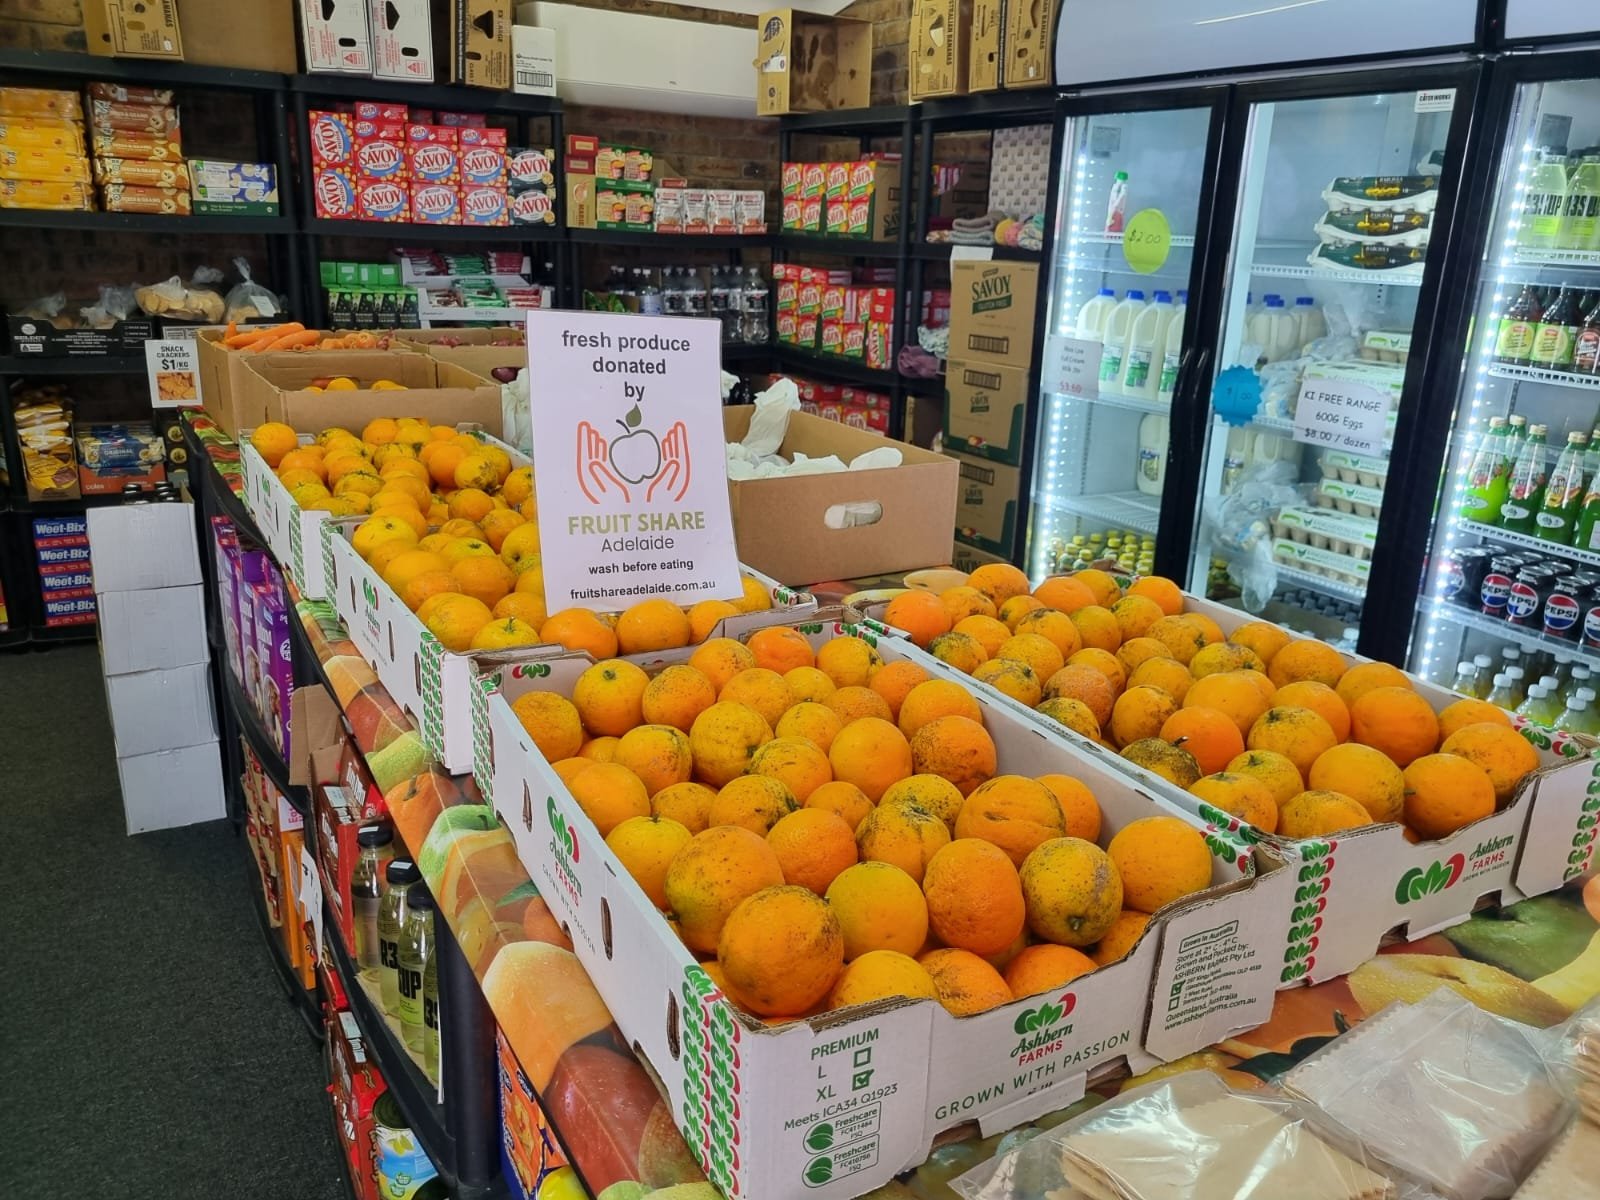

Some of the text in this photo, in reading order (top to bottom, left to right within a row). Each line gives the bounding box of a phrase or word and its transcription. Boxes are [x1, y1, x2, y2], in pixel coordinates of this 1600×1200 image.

[320, 120, 341, 163] SAVOY
[358, 149, 399, 168] SAVOY
[413, 153, 451, 170] SAVOY
[463, 155, 500, 171] SAVOY
[511, 159, 550, 177] SAVOY
[322, 174, 345, 215] SAVOY
[362, 189, 400, 208] SAVOY
[415, 193, 453, 210] SAVOY
[464, 194, 500, 211] SAVOY
[513, 197, 552, 215] SAVOY
[972, 274, 1012, 302] SAVOY
[562, 331, 691, 353] fresh produce
[592, 356, 667, 375] donated
[624, 381, 646, 401] by
[1304, 391, 1382, 412] KI FREE RANGE
[1315, 411, 1363, 430] 600G Eggs
[1305, 427, 1332, 442] $8.00
[1343, 435, 1371, 450] dozen
[36, 522, 85, 535] Weet-Bix
[568, 511, 706, 535] FRUIT SHARE
[601, 535, 675, 553] Adelaide
[40, 548, 89, 561] Weet-Bix
[589, 558, 694, 575] wash before eating
[44, 574, 93, 587] Weet-Bix
[570, 579, 716, 600] fruitshareadelaide.com.au
[1482, 583, 1510, 596] PEPS
[48, 600, 95, 613] Weet-Bix
[1546, 605, 1577, 618] PEPSI
[1469, 835, 1514, 861] Ashbern
[549, 836, 583, 898] Ashbern
[1472, 851, 1505, 872] FARMS
[554, 861, 580, 907] FARMS
[1176, 952, 1194, 964] Store
[1229, 952, 1242, 962] Pty
[1243, 949, 1256, 958] Ltd
[811, 1028, 880, 1060] PREMIUM
[1010, 1023, 1073, 1058] Ashbern
[1018, 1040, 1063, 1066] FARMS
[817, 1065, 827, 1079] L
[935, 1083, 1004, 1120] GROWN
[1013, 1062, 1055, 1090] WITH
[1063, 1030, 1130, 1069] PASSION
[816, 1084, 837, 1102] XL
[784, 1083, 898, 1131] Meets ICA34 Q1923
[834, 1107, 878, 1129] Freshcare
[833, 1140, 877, 1163] Freshcare
